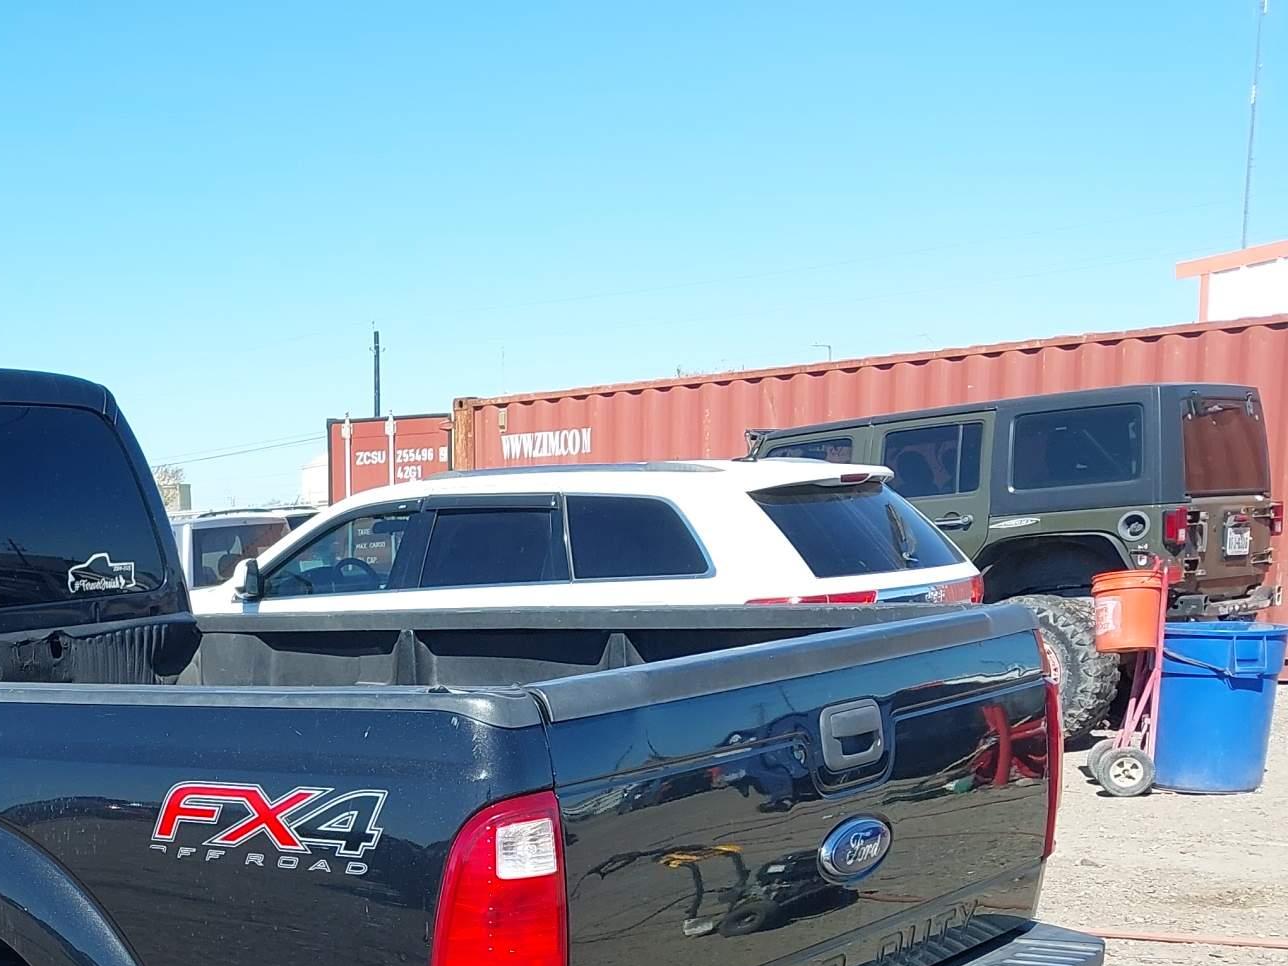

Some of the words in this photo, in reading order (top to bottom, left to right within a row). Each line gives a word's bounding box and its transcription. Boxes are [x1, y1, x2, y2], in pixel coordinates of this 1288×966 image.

[355, 451, 387, 465] ZCSU
[396, 448, 434, 463] 255496
[396, 465, 422, 479] 42G1
[151, 780, 389, 858] FX4
[846, 830, 882, 866] Ford
[245, 852, 369, 875] ROAD
